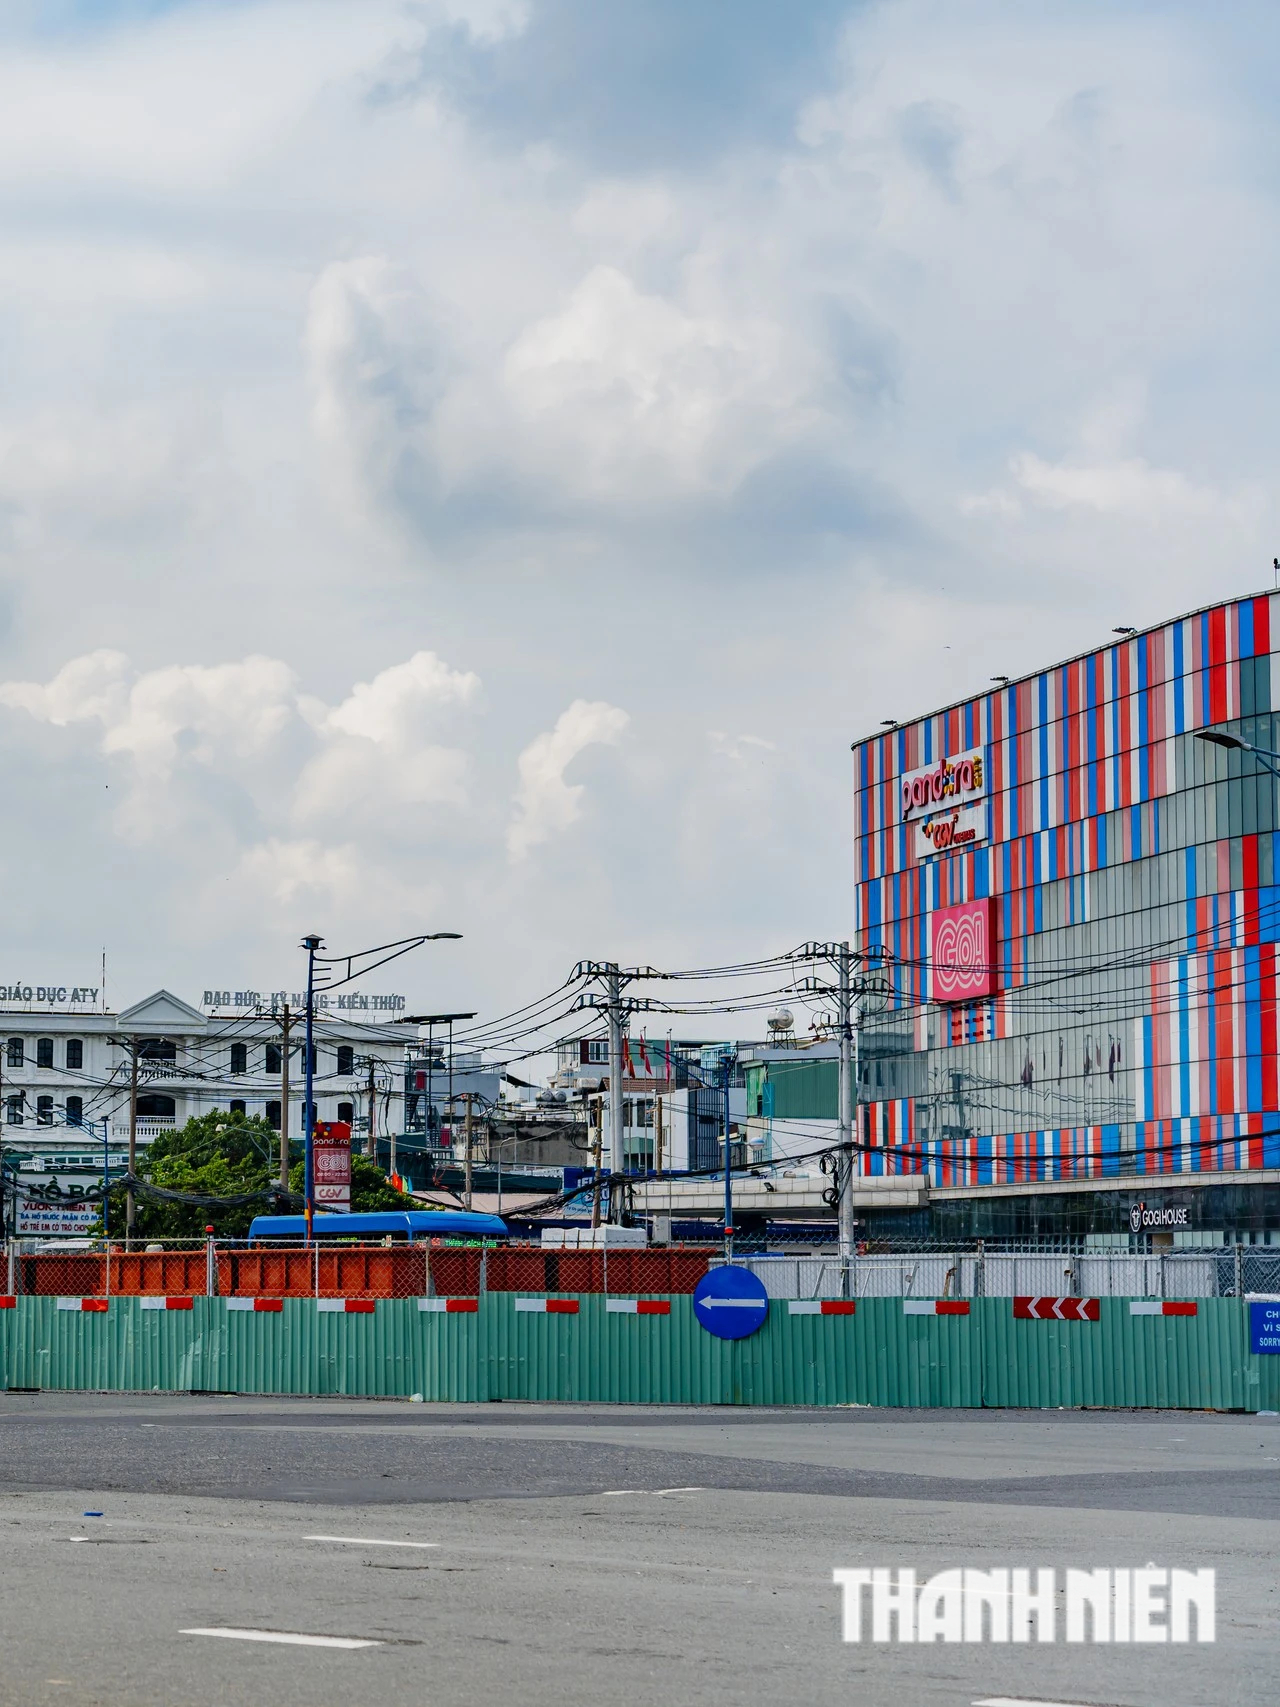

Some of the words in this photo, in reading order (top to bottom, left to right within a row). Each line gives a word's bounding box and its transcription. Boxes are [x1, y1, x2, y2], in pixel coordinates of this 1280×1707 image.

[936, 911, 985, 992] GO!
[71, 988, 99, 1002] ATY
[317, 1154, 348, 1171] GO!
[319, 1188, 342, 1198] CGV
[1266, 1310, 1280, 1318] CH
